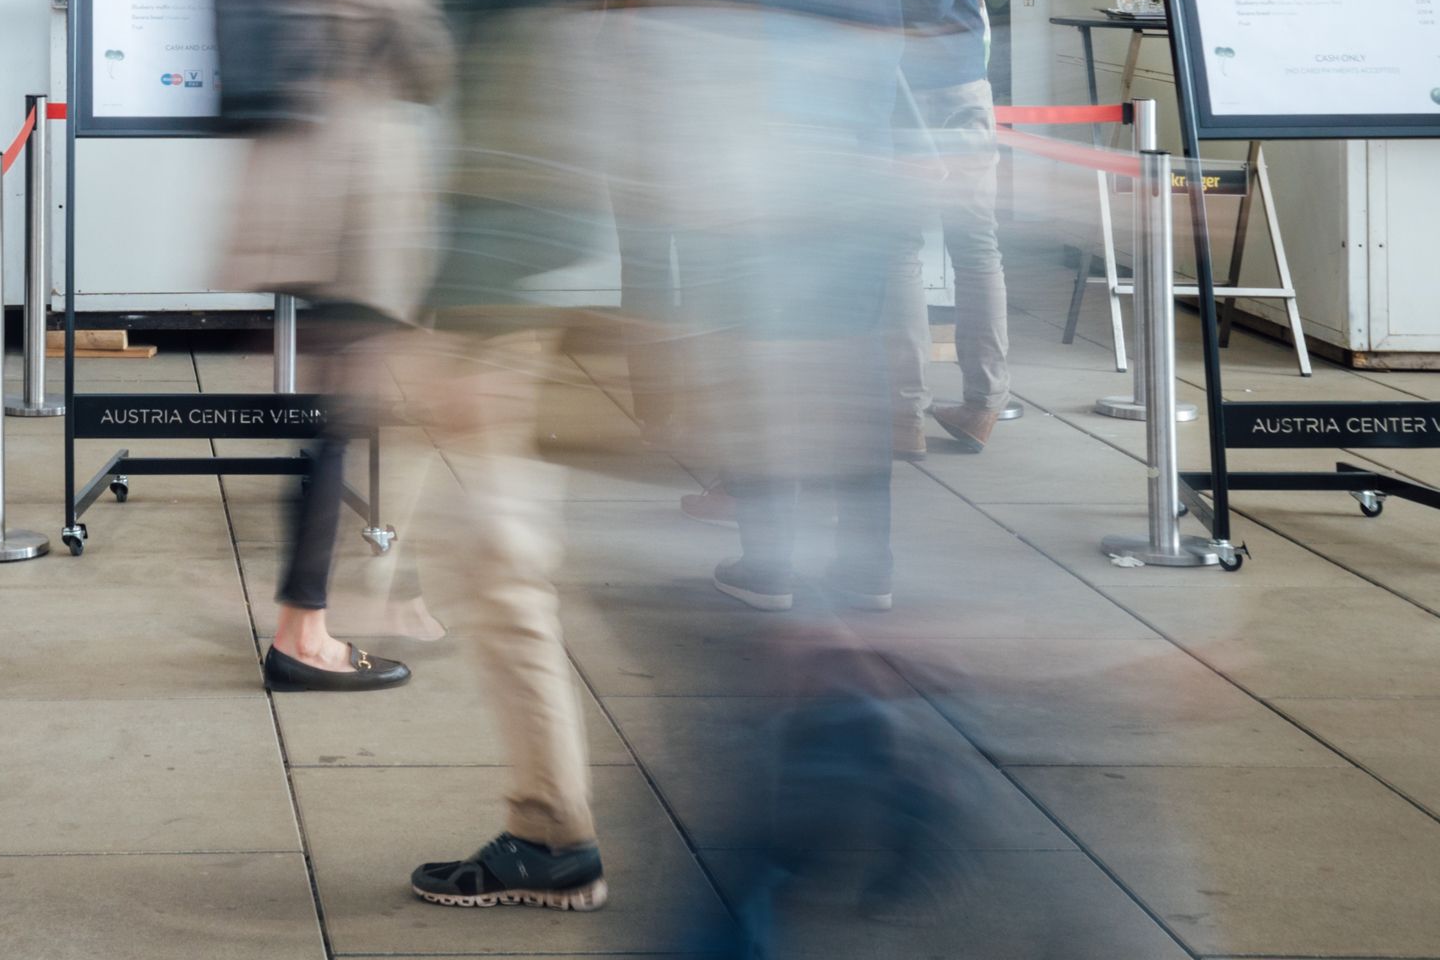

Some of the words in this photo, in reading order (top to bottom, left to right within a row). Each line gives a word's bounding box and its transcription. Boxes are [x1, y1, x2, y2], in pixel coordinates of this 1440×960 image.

[101, 409, 182, 424] AUSTRIA
[189, 409, 264, 424] CENTER
[1252, 417, 1341, 433] AUSTRIA
[1346, 417, 1428, 433] CENTER
